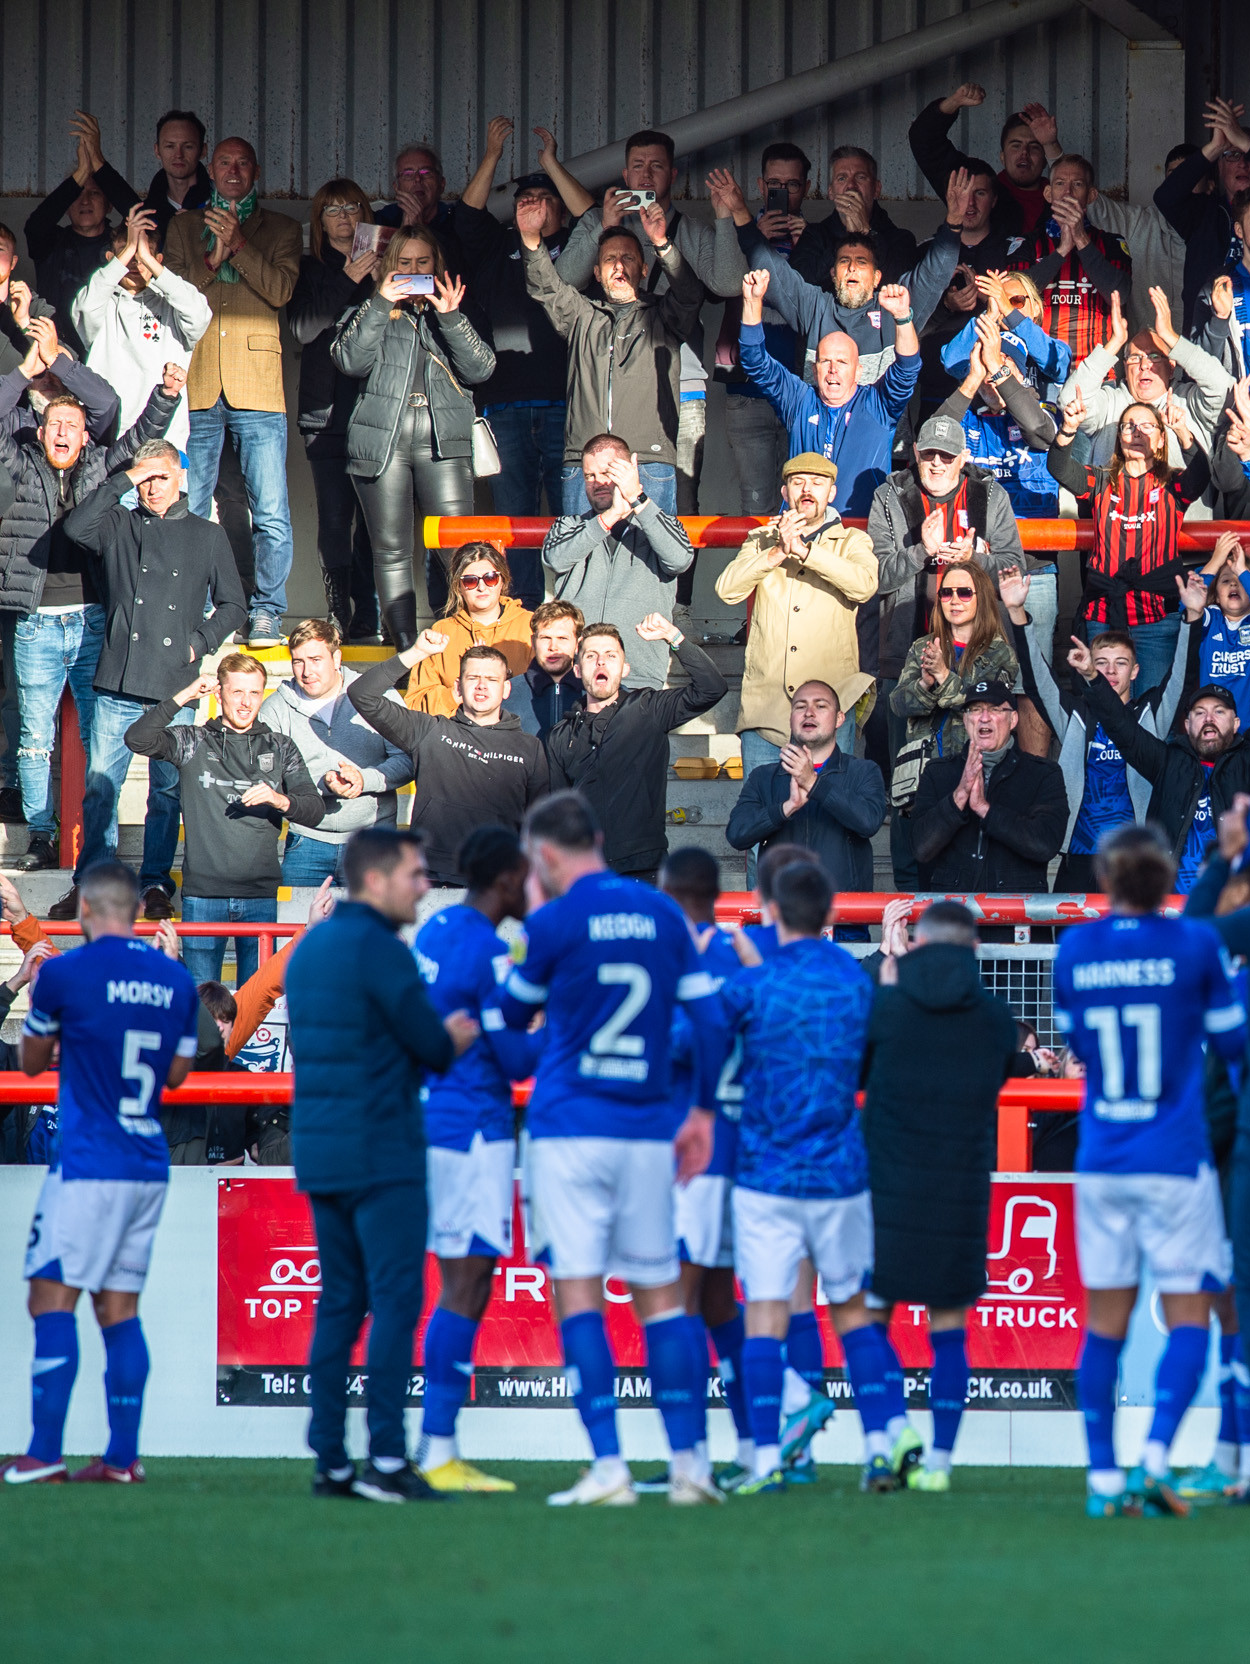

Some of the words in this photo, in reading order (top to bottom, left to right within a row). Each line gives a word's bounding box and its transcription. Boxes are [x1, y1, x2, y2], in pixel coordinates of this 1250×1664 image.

[1051, 294, 1082, 305] TOUR
[1211, 661, 1247, 675] TRUST
[440, 733, 474, 752] TOMMY
[1095, 750, 1122, 761] OUR
[105, 979, 175, 1010] MORSY
[588, 962, 653, 1057] 2
[1083, 1002, 1163, 1101] 11
[118, 1028, 163, 1117] 5
[244, 1298, 303, 1319] TOP
[975, 1305, 1079, 1329] TRUCK
[261, 1373, 296, 1395] Tel:
